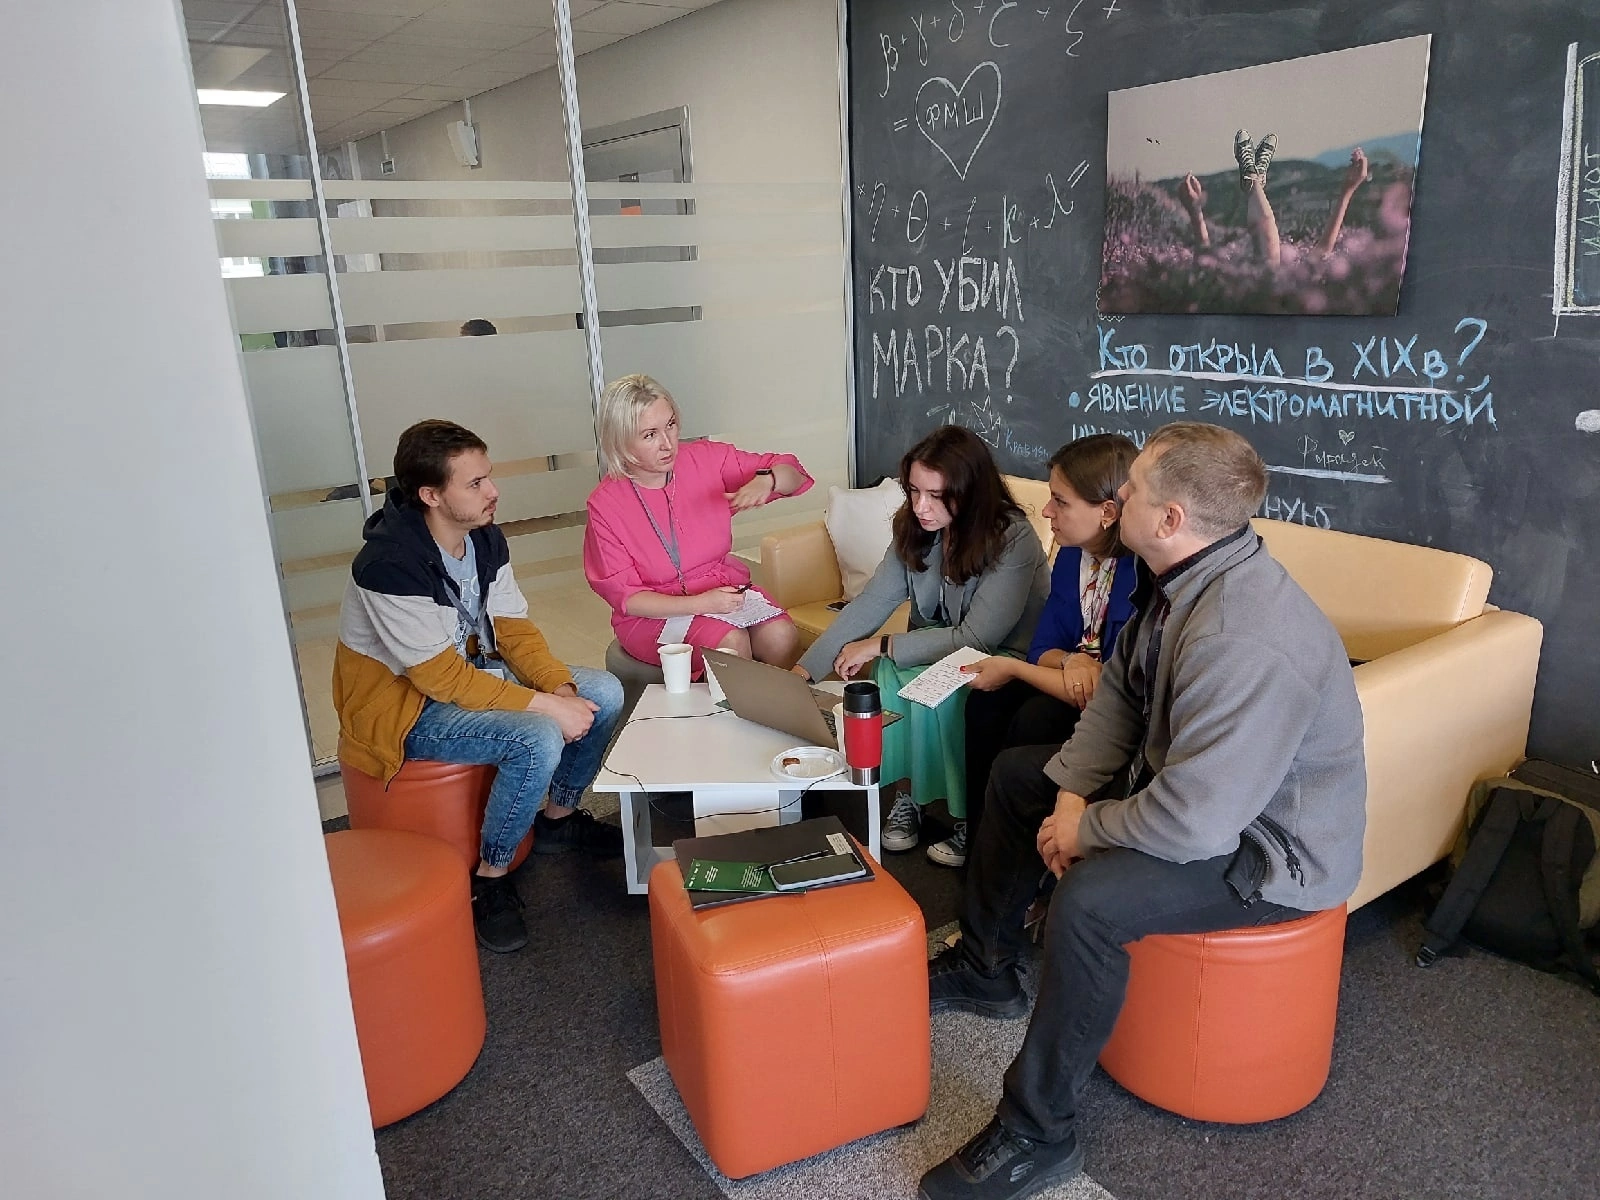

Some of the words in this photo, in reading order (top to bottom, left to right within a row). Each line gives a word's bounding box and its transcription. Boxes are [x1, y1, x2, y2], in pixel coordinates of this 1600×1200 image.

[925, 90, 984, 132] ФМШ
[868, 263, 922, 314] КТО
[933, 256, 1025, 322] УБИЛ
[872, 324, 1020, 404] МАРКА?
[1083, 382, 1189, 414] ЯВЛЕНИЕ
[1198, 375, 1498, 430] ЭЛЕКТРОМАГНИТНОЙ
